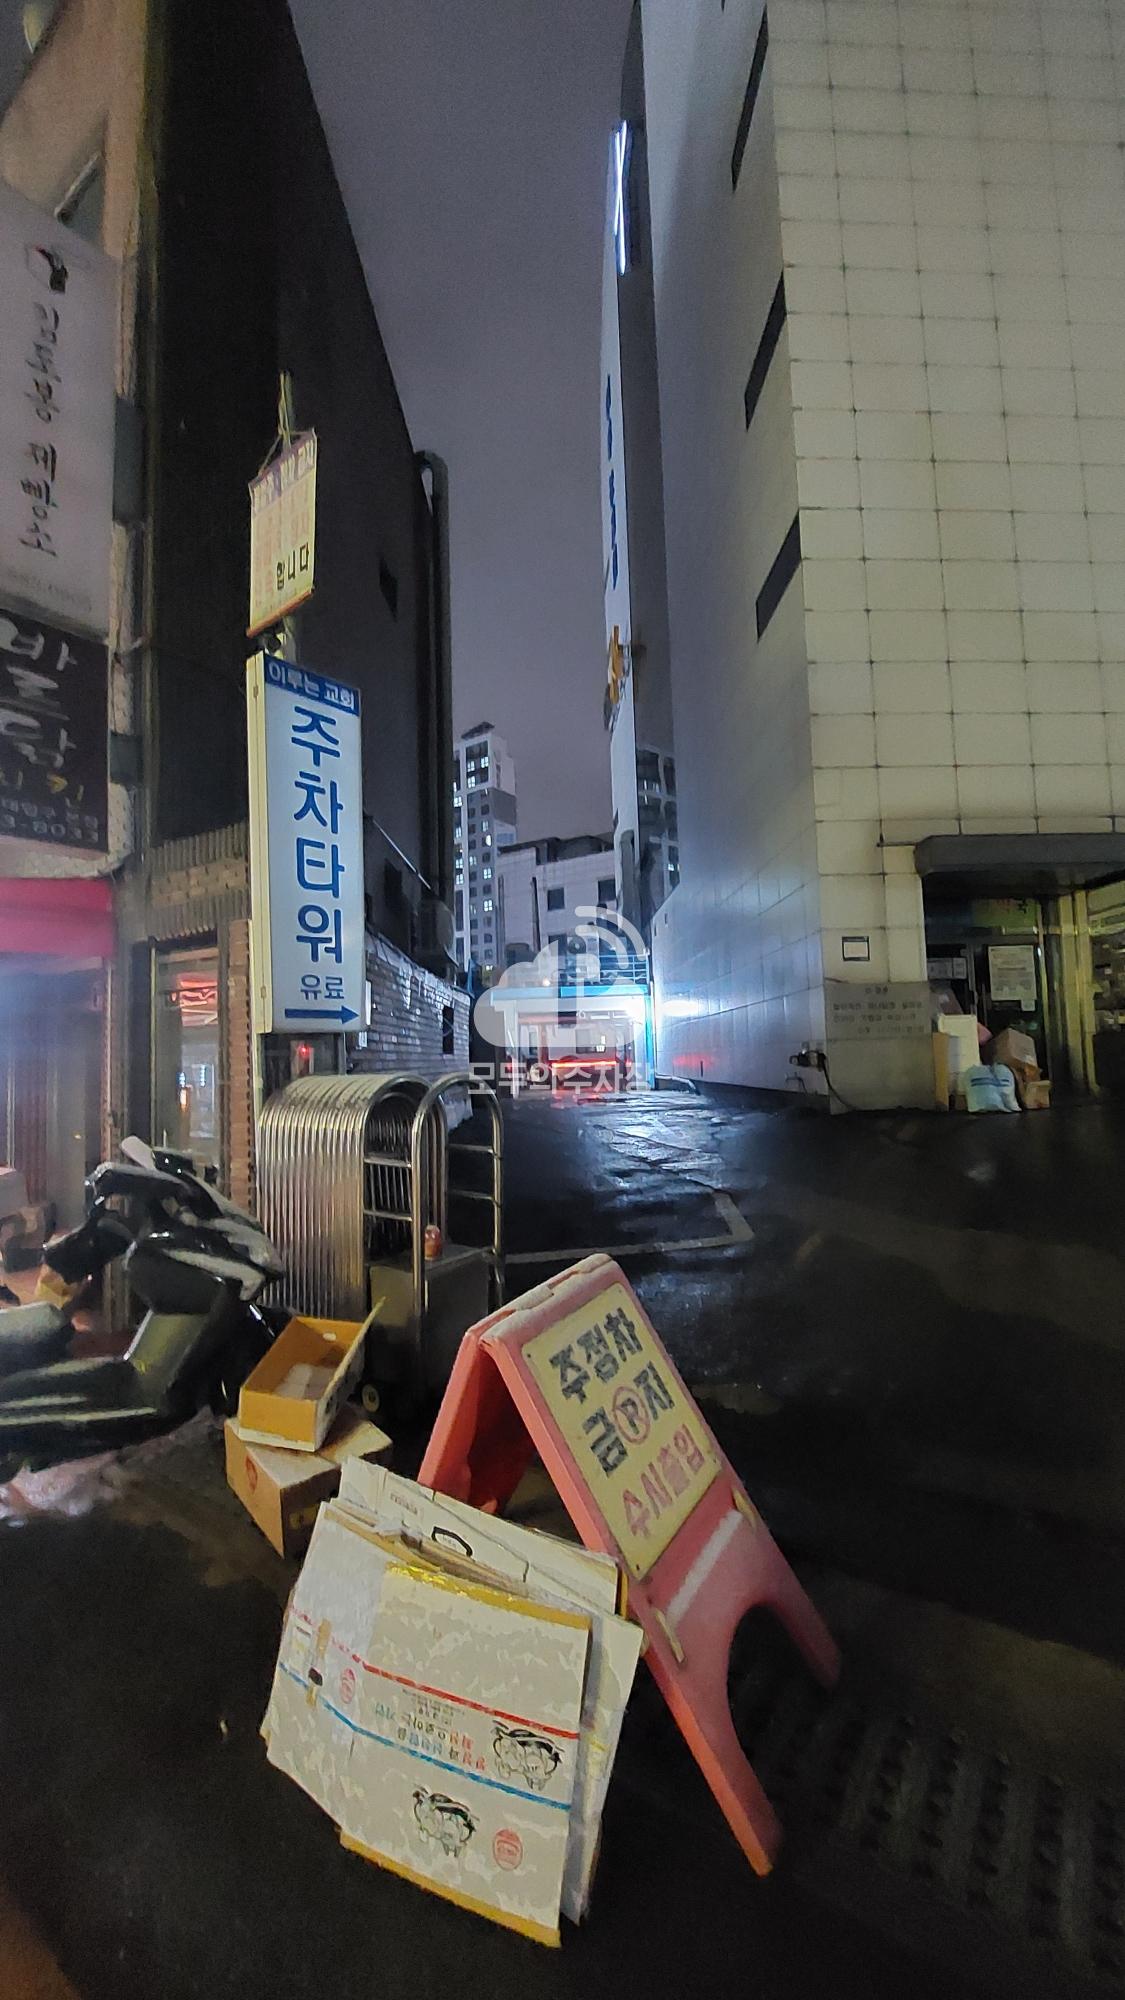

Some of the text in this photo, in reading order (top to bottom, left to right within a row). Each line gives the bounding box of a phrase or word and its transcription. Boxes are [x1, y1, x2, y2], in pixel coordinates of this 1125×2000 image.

[268, 661, 355, 711] 이루는 교회
[291, 705, 346, 964] 주차타워
[299, 973, 346, 1001] 유료
[550, 1307, 643, 1405] 주정차
